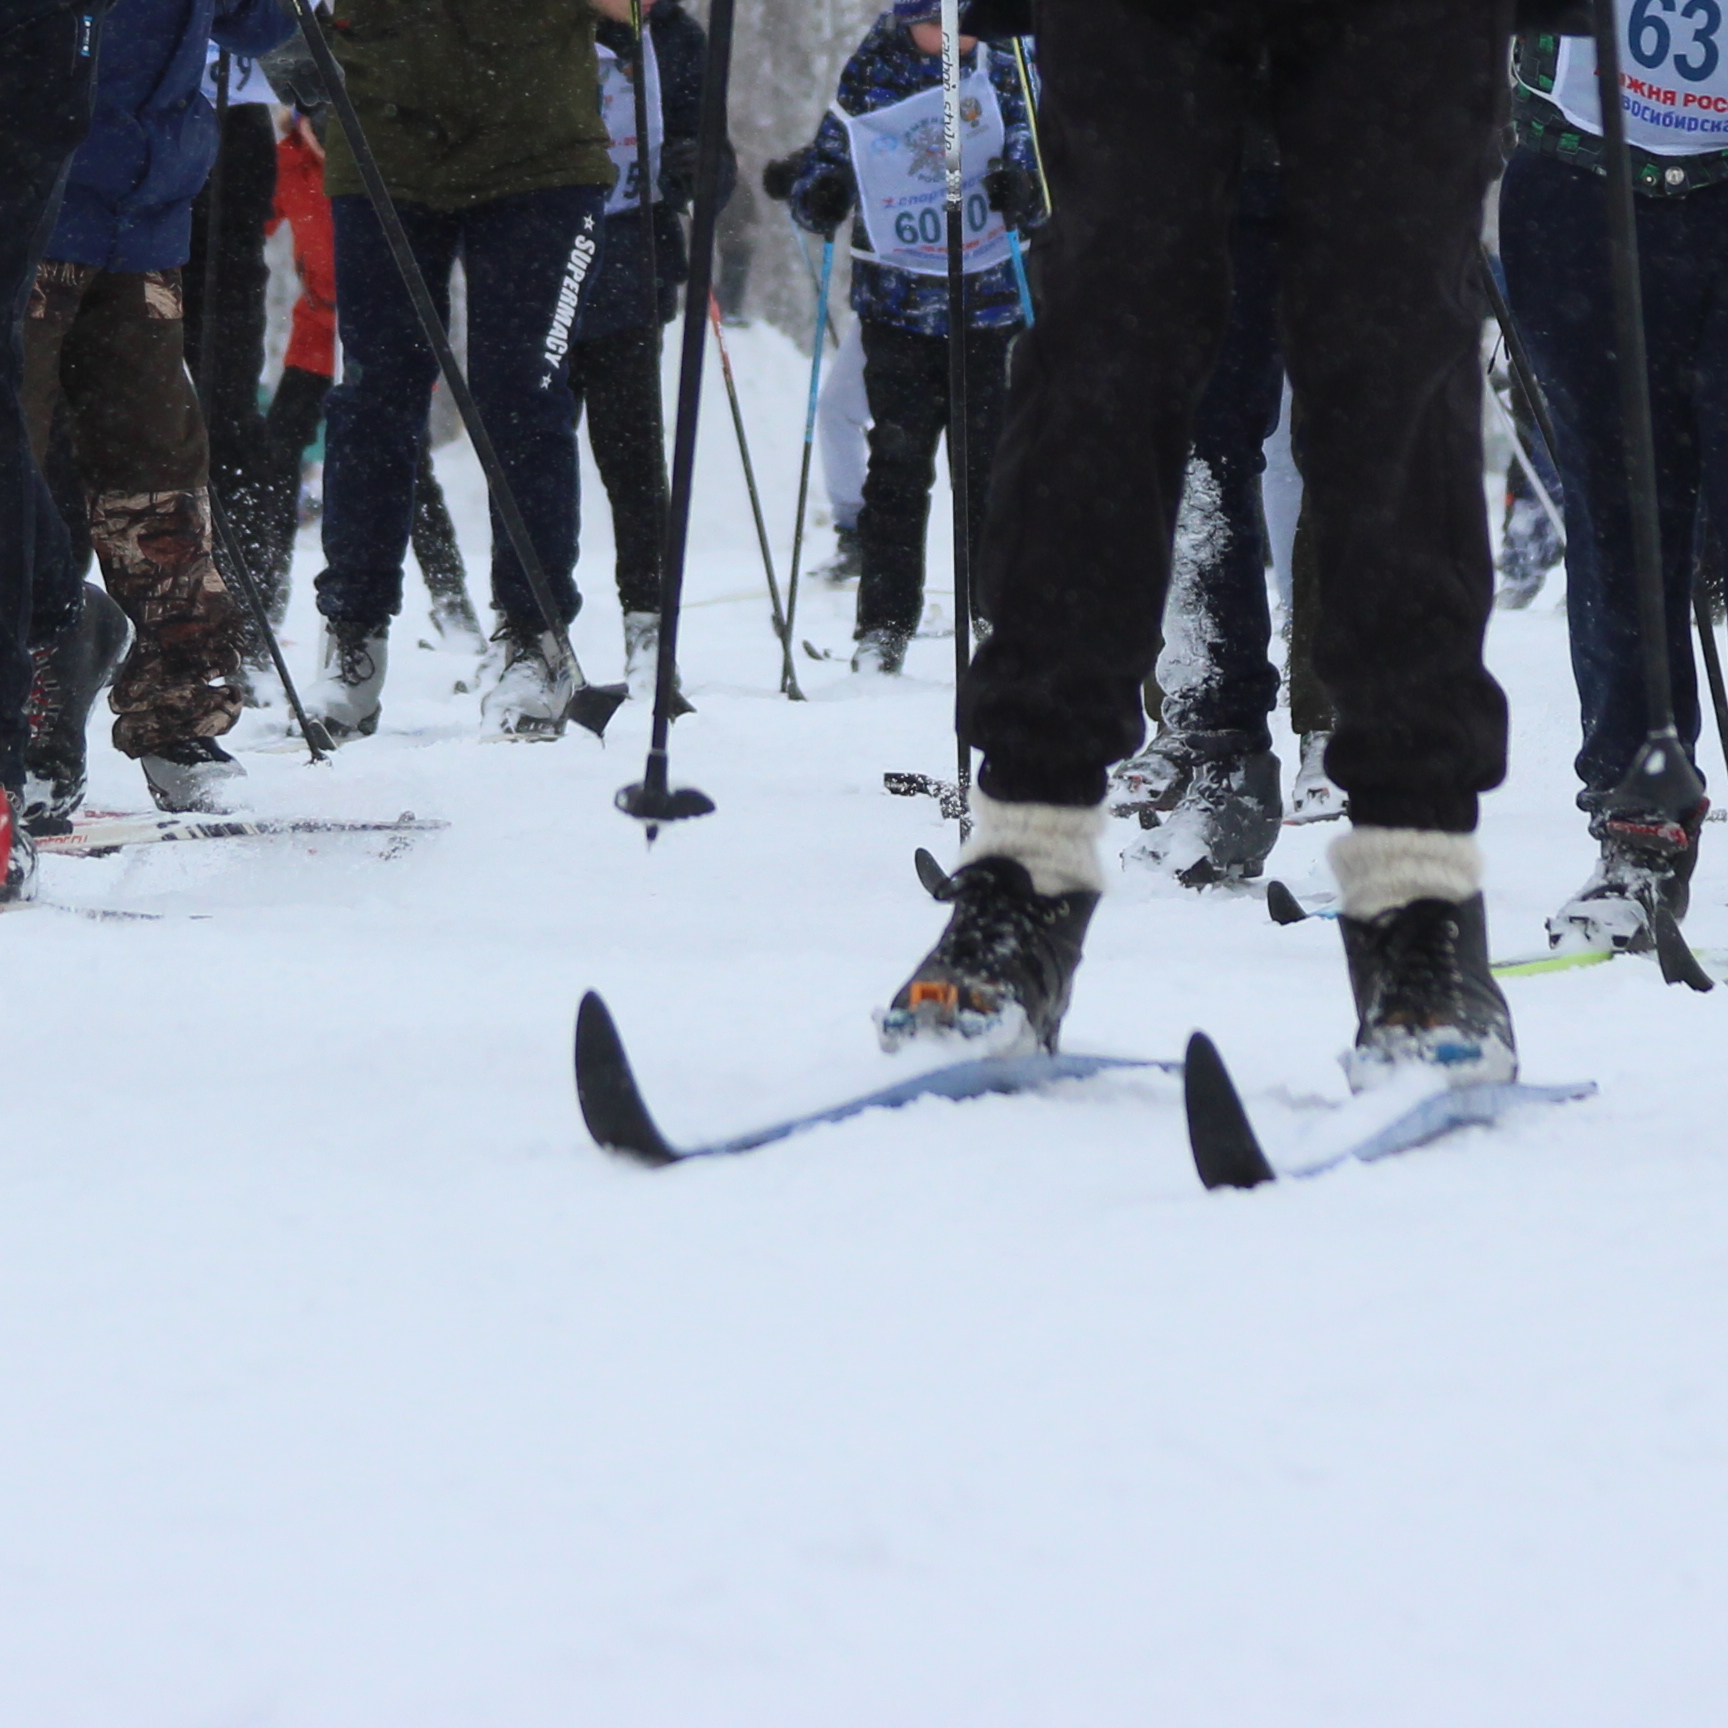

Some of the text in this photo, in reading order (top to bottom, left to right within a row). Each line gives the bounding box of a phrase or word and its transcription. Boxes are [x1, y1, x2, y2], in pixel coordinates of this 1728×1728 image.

[1618, 72, 1677, 107] ЖНЯ
[894, 193, 989, 246] 600
[544, 233, 596, 369] SUPERMACY
